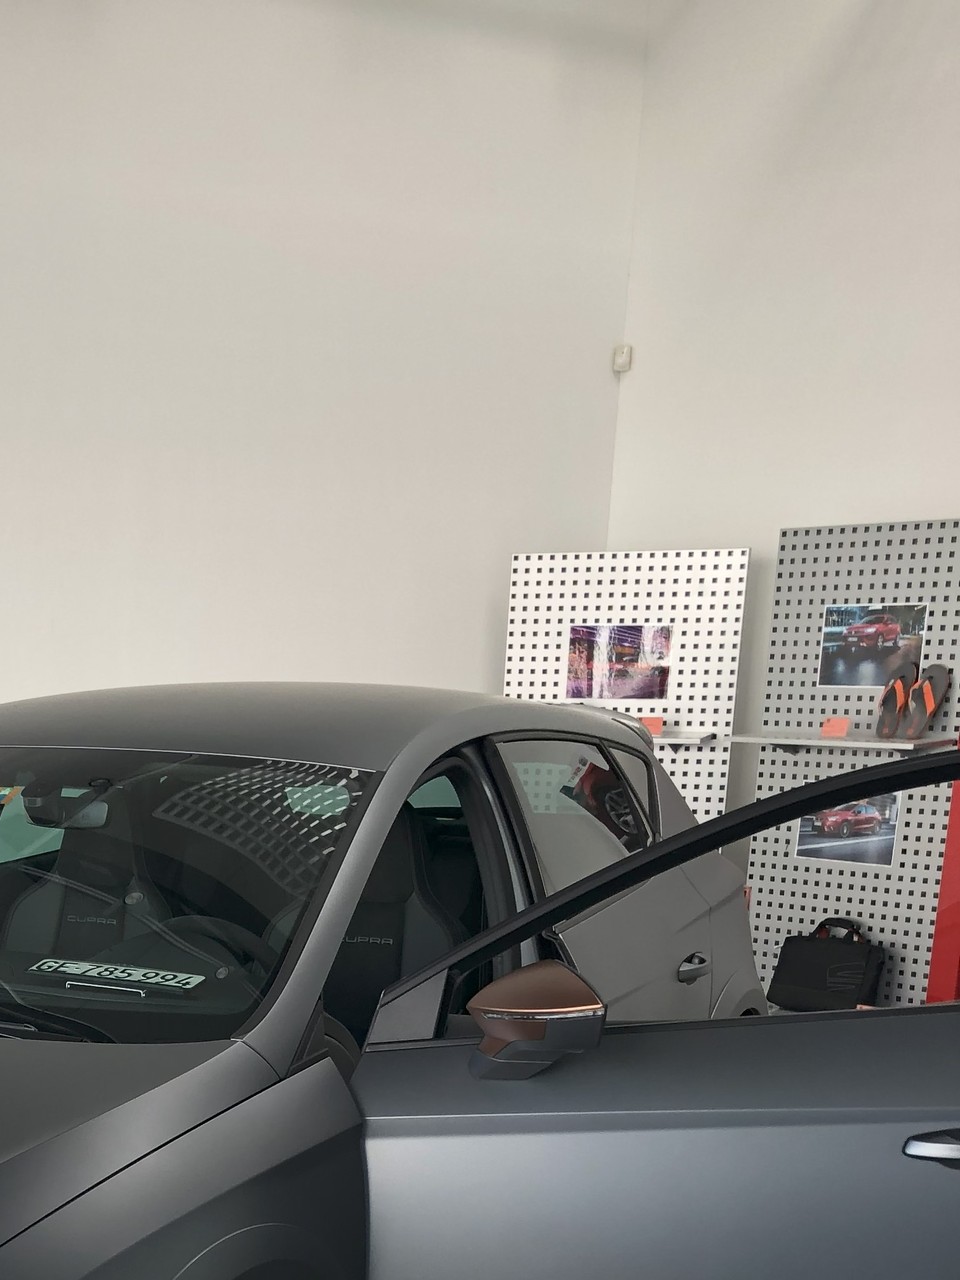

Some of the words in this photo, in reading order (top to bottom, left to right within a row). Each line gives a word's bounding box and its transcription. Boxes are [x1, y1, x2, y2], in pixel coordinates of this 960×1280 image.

[67, 915, 116, 925] CUPRA
[343, 936, 393, 945] UPRA
[141, 971, 195, 988] 994
